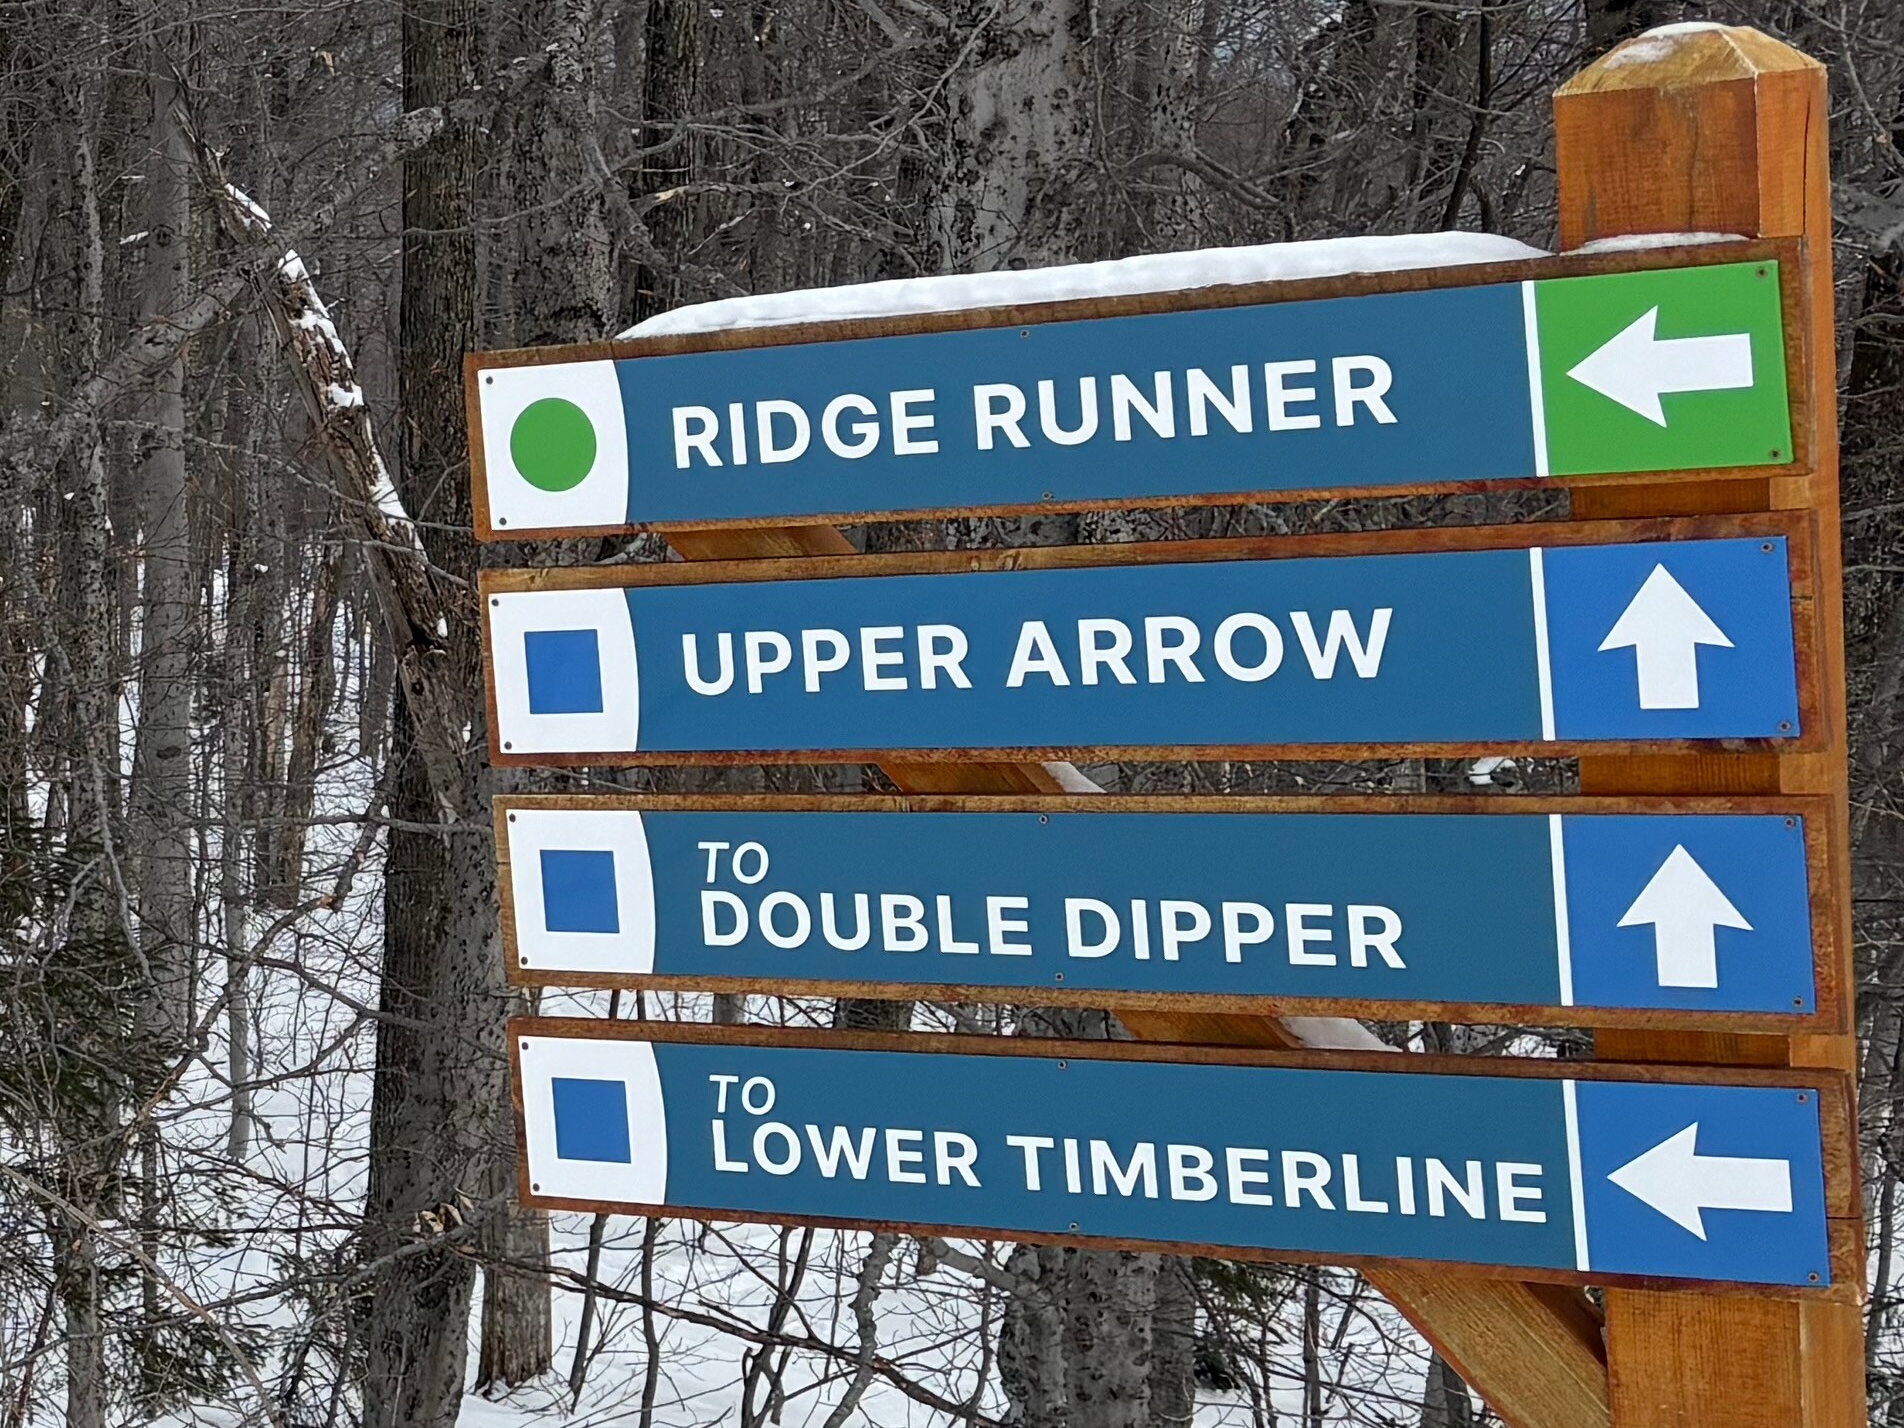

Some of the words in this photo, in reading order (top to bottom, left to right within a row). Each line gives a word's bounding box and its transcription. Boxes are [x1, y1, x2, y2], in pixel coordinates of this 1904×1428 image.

[671, 387, 940, 470] RIDGE
[972, 354, 1399, 451] RUNNER
[681, 623, 974, 697] UPPER
[1004, 606, 1394, 689] ARROW
[696, 840, 770, 886] TO
[699, 889, 1034, 957] DOUBLE
[1063, 896, 1408, 970] DIPPER
[708, 1073, 777, 1117] TO
[710, 1118, 983, 1188] LOWER
[1005, 1134, 1548, 1224] TIMBERLINE
